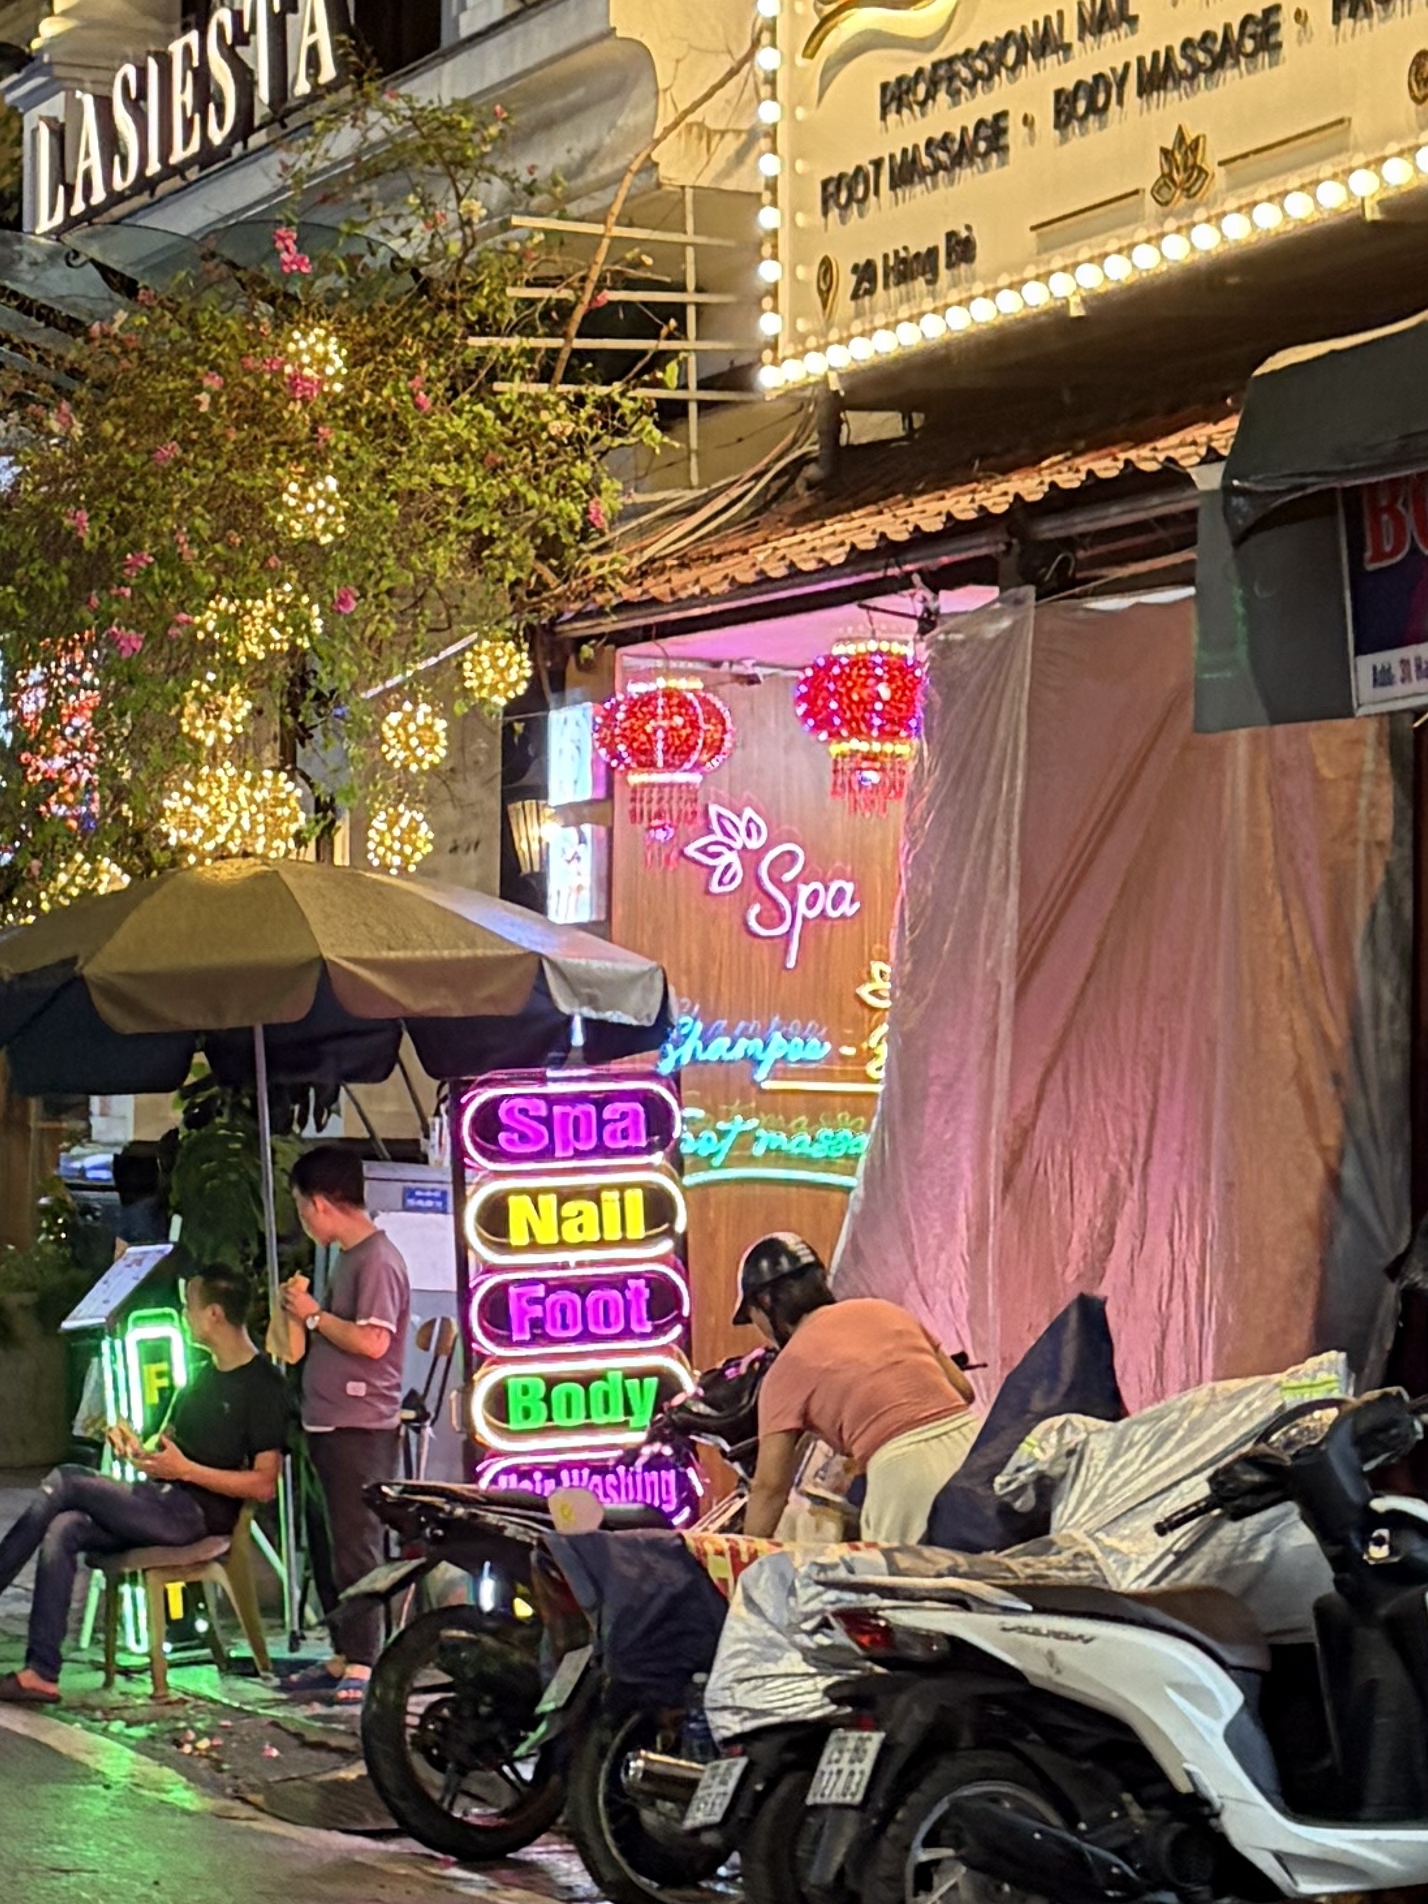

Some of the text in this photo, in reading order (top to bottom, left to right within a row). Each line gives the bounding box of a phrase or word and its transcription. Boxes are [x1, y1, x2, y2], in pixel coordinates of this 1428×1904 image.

[880, 8, 1072, 122] PROFESSIONAL
[1053, 3, 1283, 132] BODY MASSAGE
[820, 109, 1010, 218] FOOT MASSAGE
[849, 259, 878, 301] 29
[746, 843, 861, 969] Spa
[497, 1097, 647, 1158] Spa
[507, 1188, 646, 1247] Nail
[508, 1279, 651, 1342] Foot
[506, 1371, 660, 1431] Body
